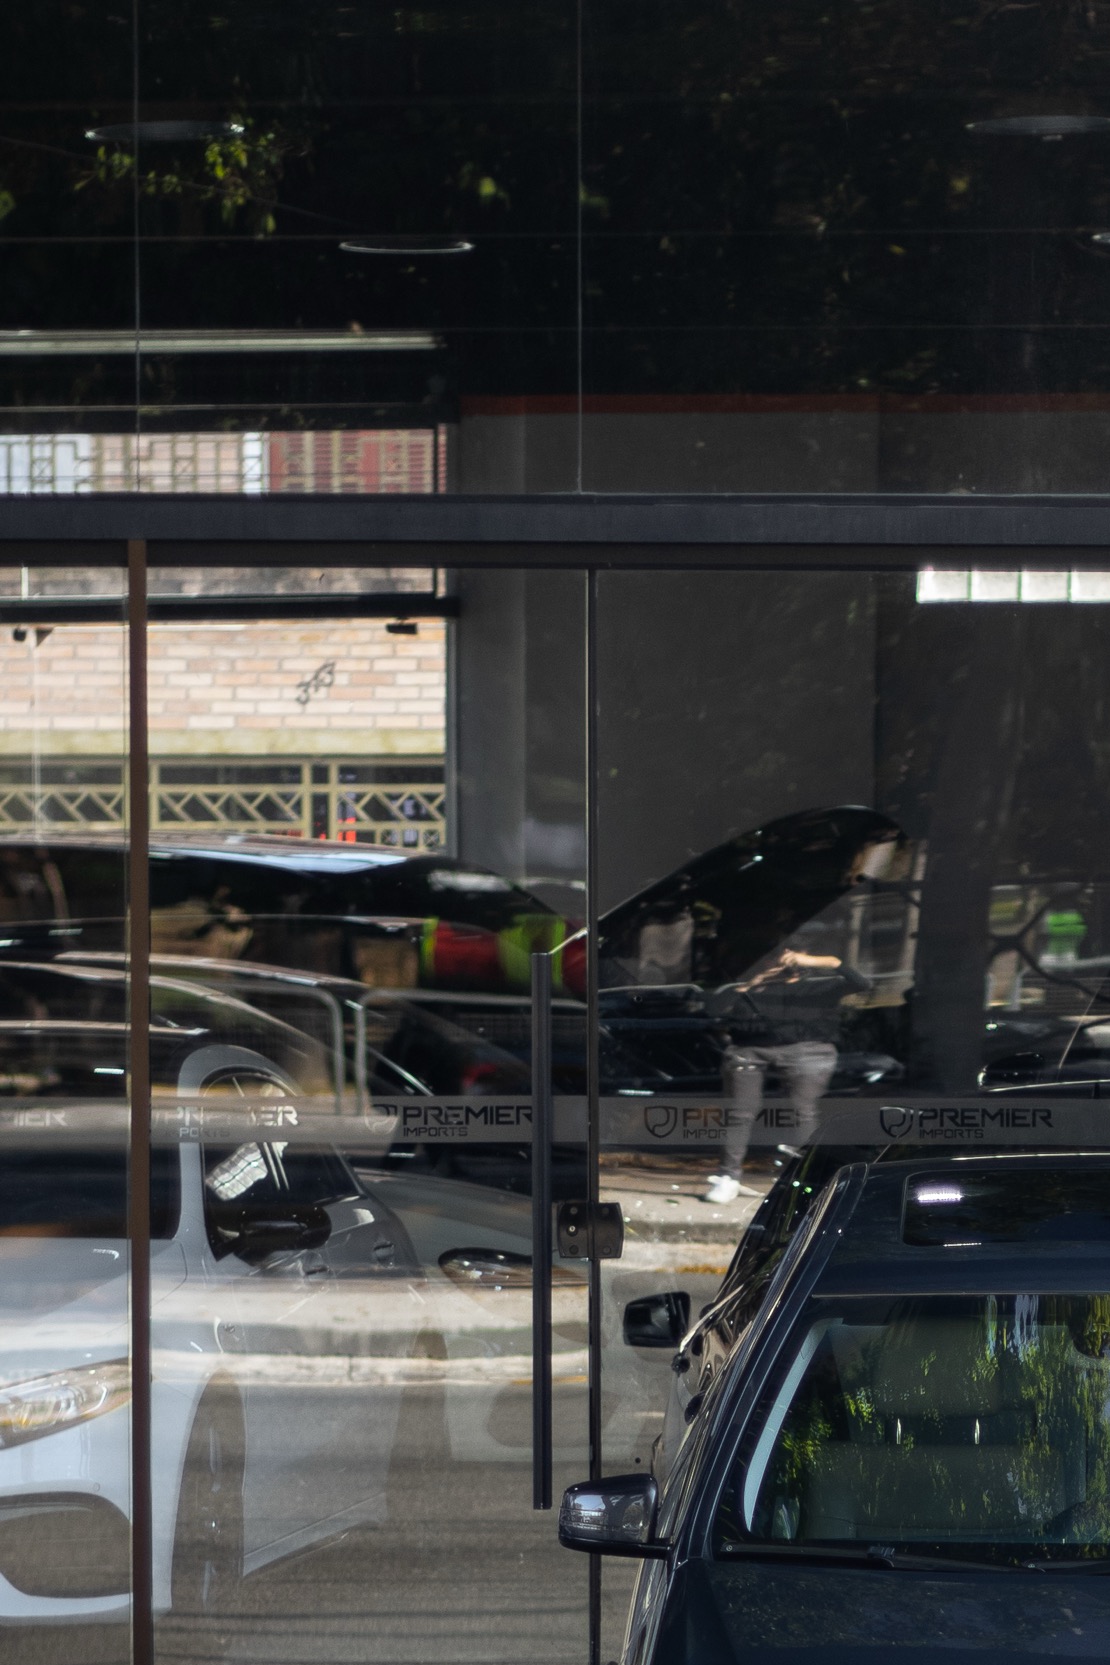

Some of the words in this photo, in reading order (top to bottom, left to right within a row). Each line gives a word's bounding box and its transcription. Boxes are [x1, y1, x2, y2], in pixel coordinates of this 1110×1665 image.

[919, 1108, 1054, 1128] PREMIER
[403, 1126, 468, 1137] IMPORTS
[919, 1128, 984, 1139] IMPORTS
